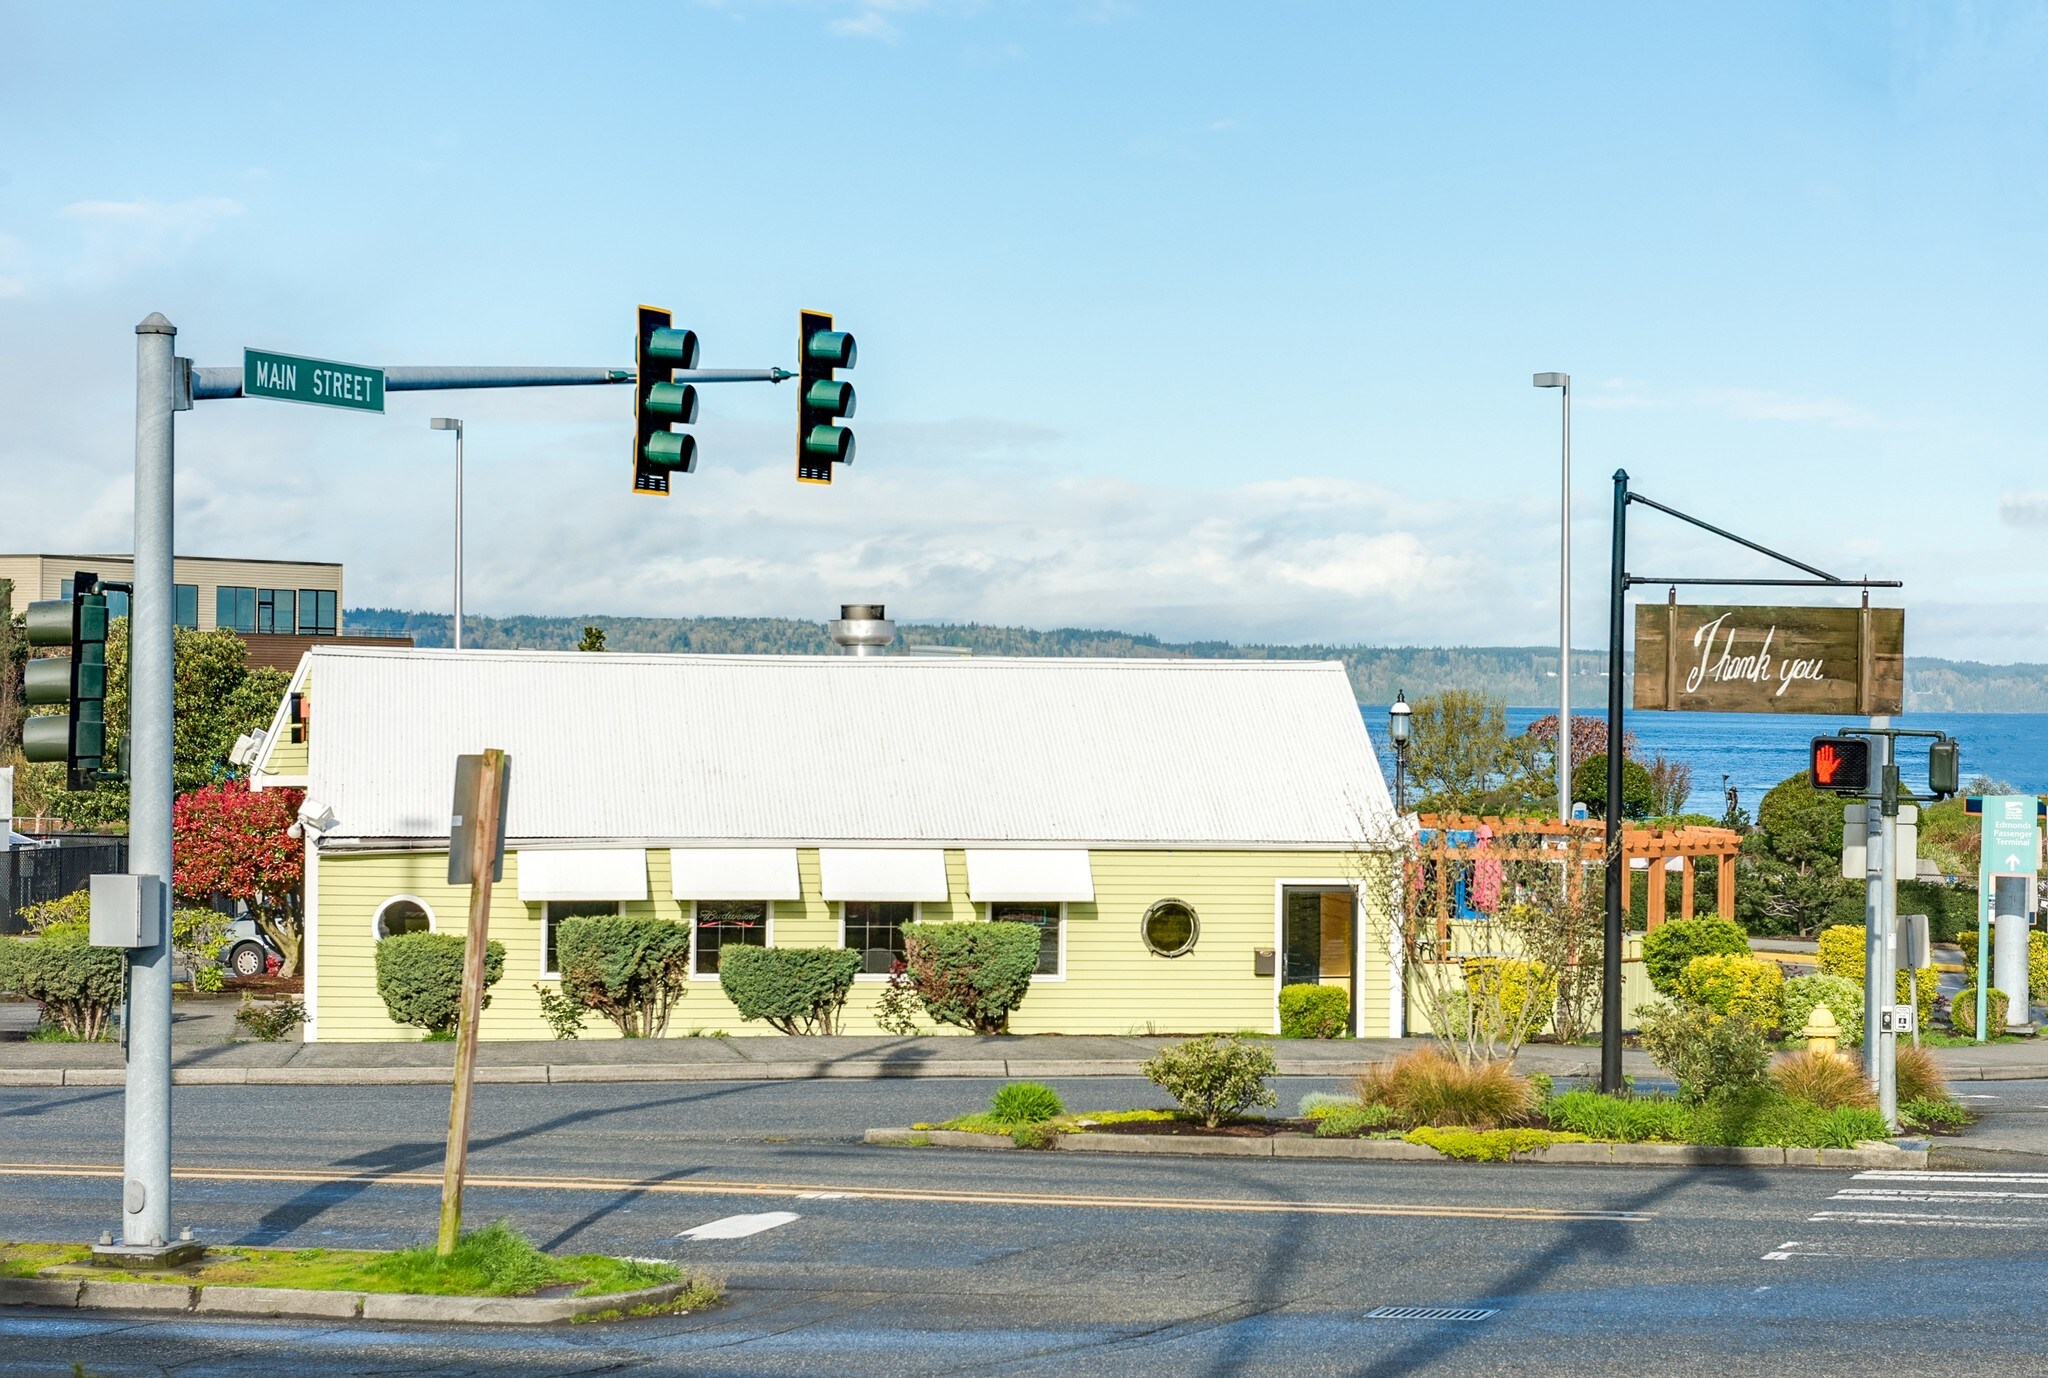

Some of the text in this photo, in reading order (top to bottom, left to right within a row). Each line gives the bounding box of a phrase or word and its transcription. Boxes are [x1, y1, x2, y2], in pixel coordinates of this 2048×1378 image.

[256, 360, 373, 402] MAIN STREET
[1686, 612, 1823, 696] Thank you
[1995, 821, 2032, 829] Edmonds
[1993, 829, 2033, 838] Passenger
[1995, 838, 2030, 846] Terminal
[699, 910, 760, 921] Budweiser
